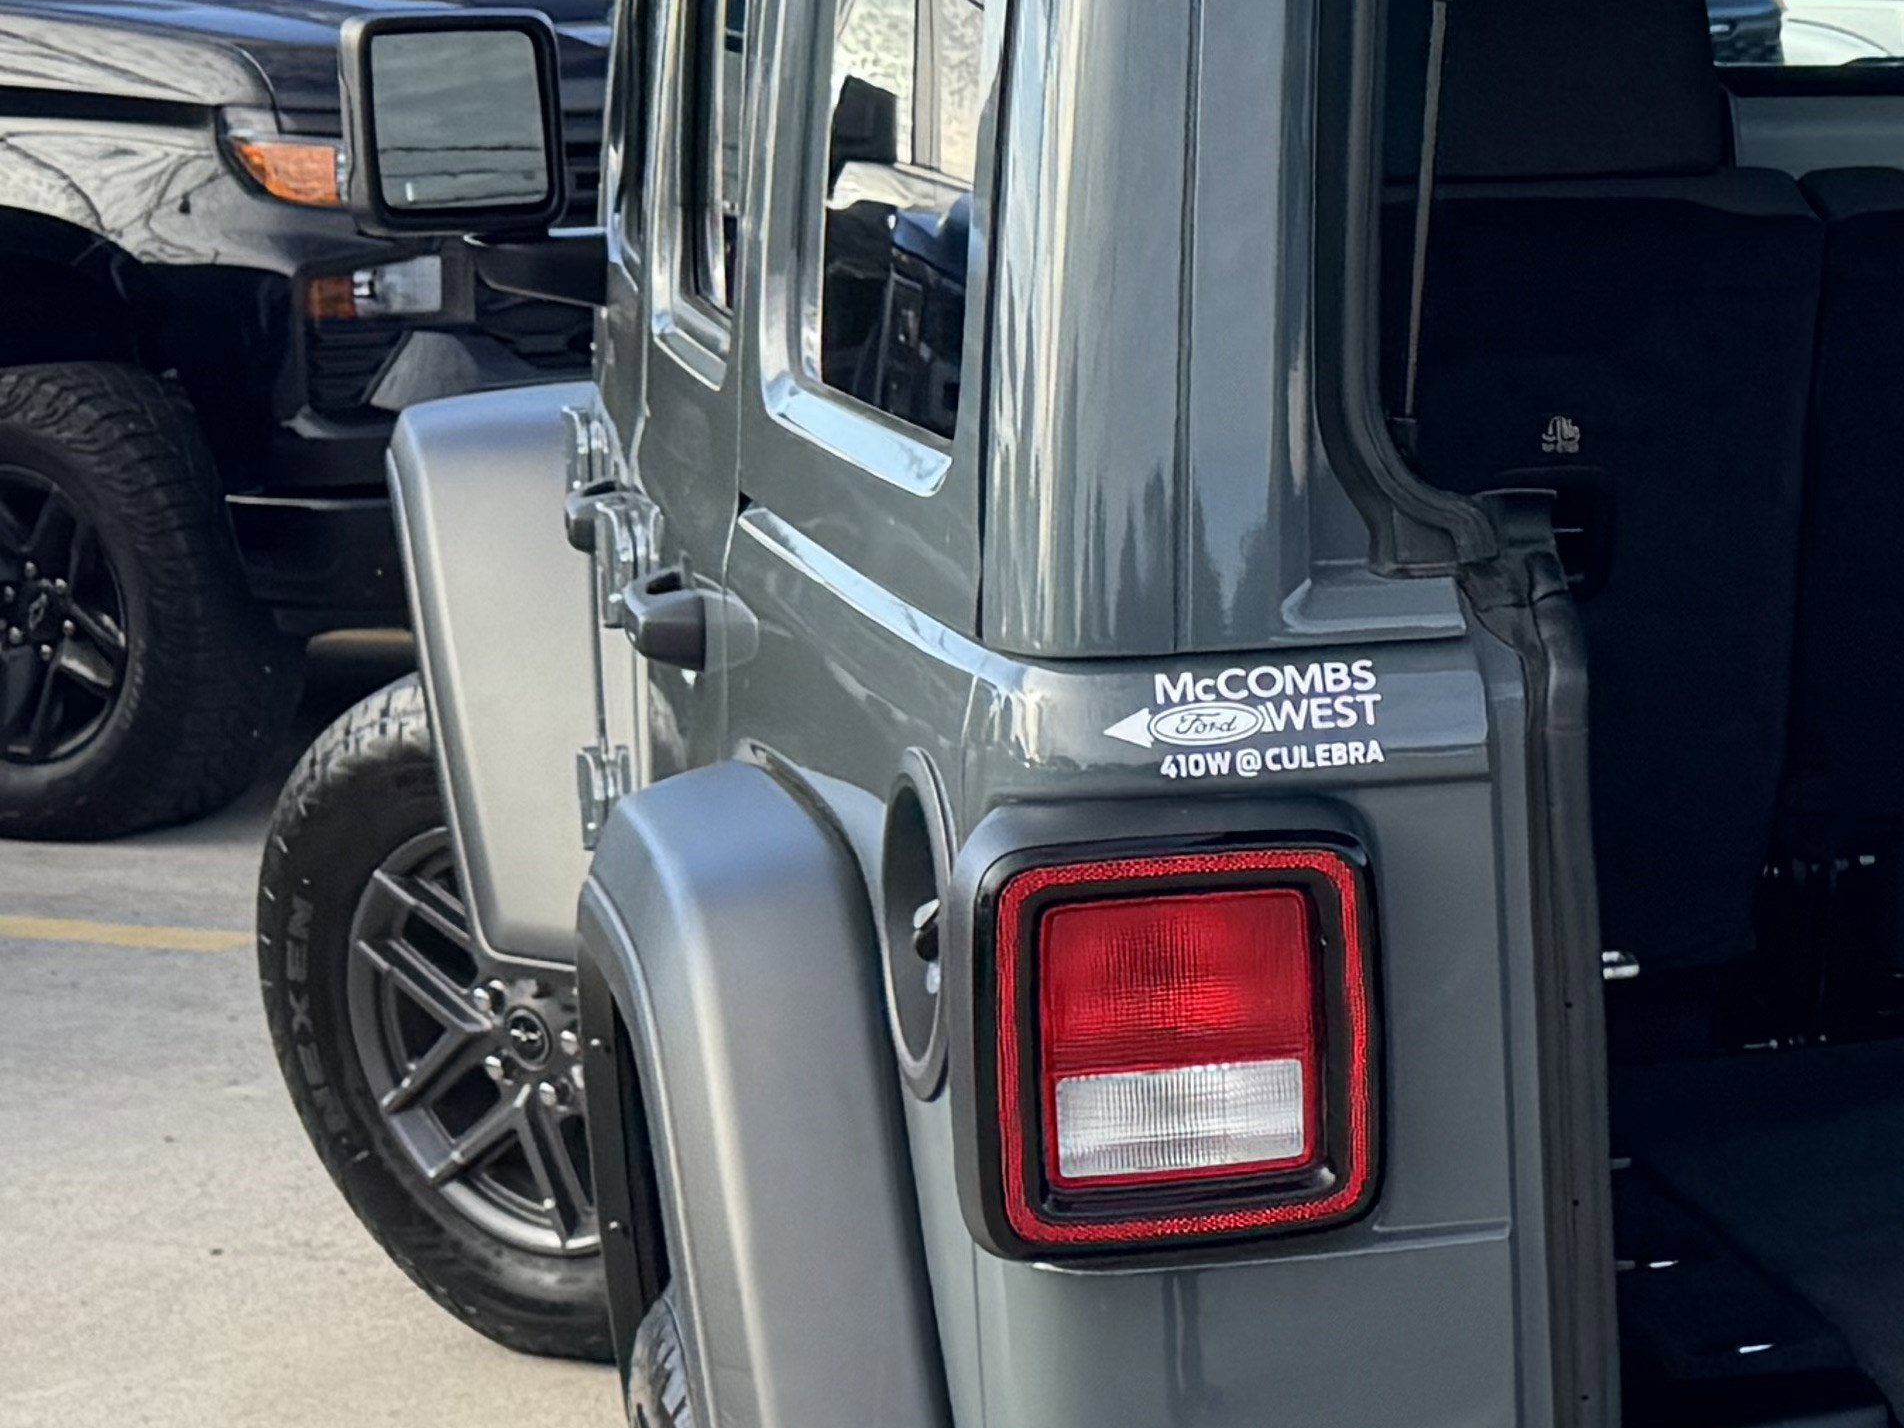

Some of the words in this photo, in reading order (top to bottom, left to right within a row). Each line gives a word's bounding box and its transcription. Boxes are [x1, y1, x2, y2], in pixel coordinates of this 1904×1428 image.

[1154, 659, 1377, 705] McCOMBS
[1176, 712, 1238, 735] Ford
[1266, 693, 1382, 732] WEST
